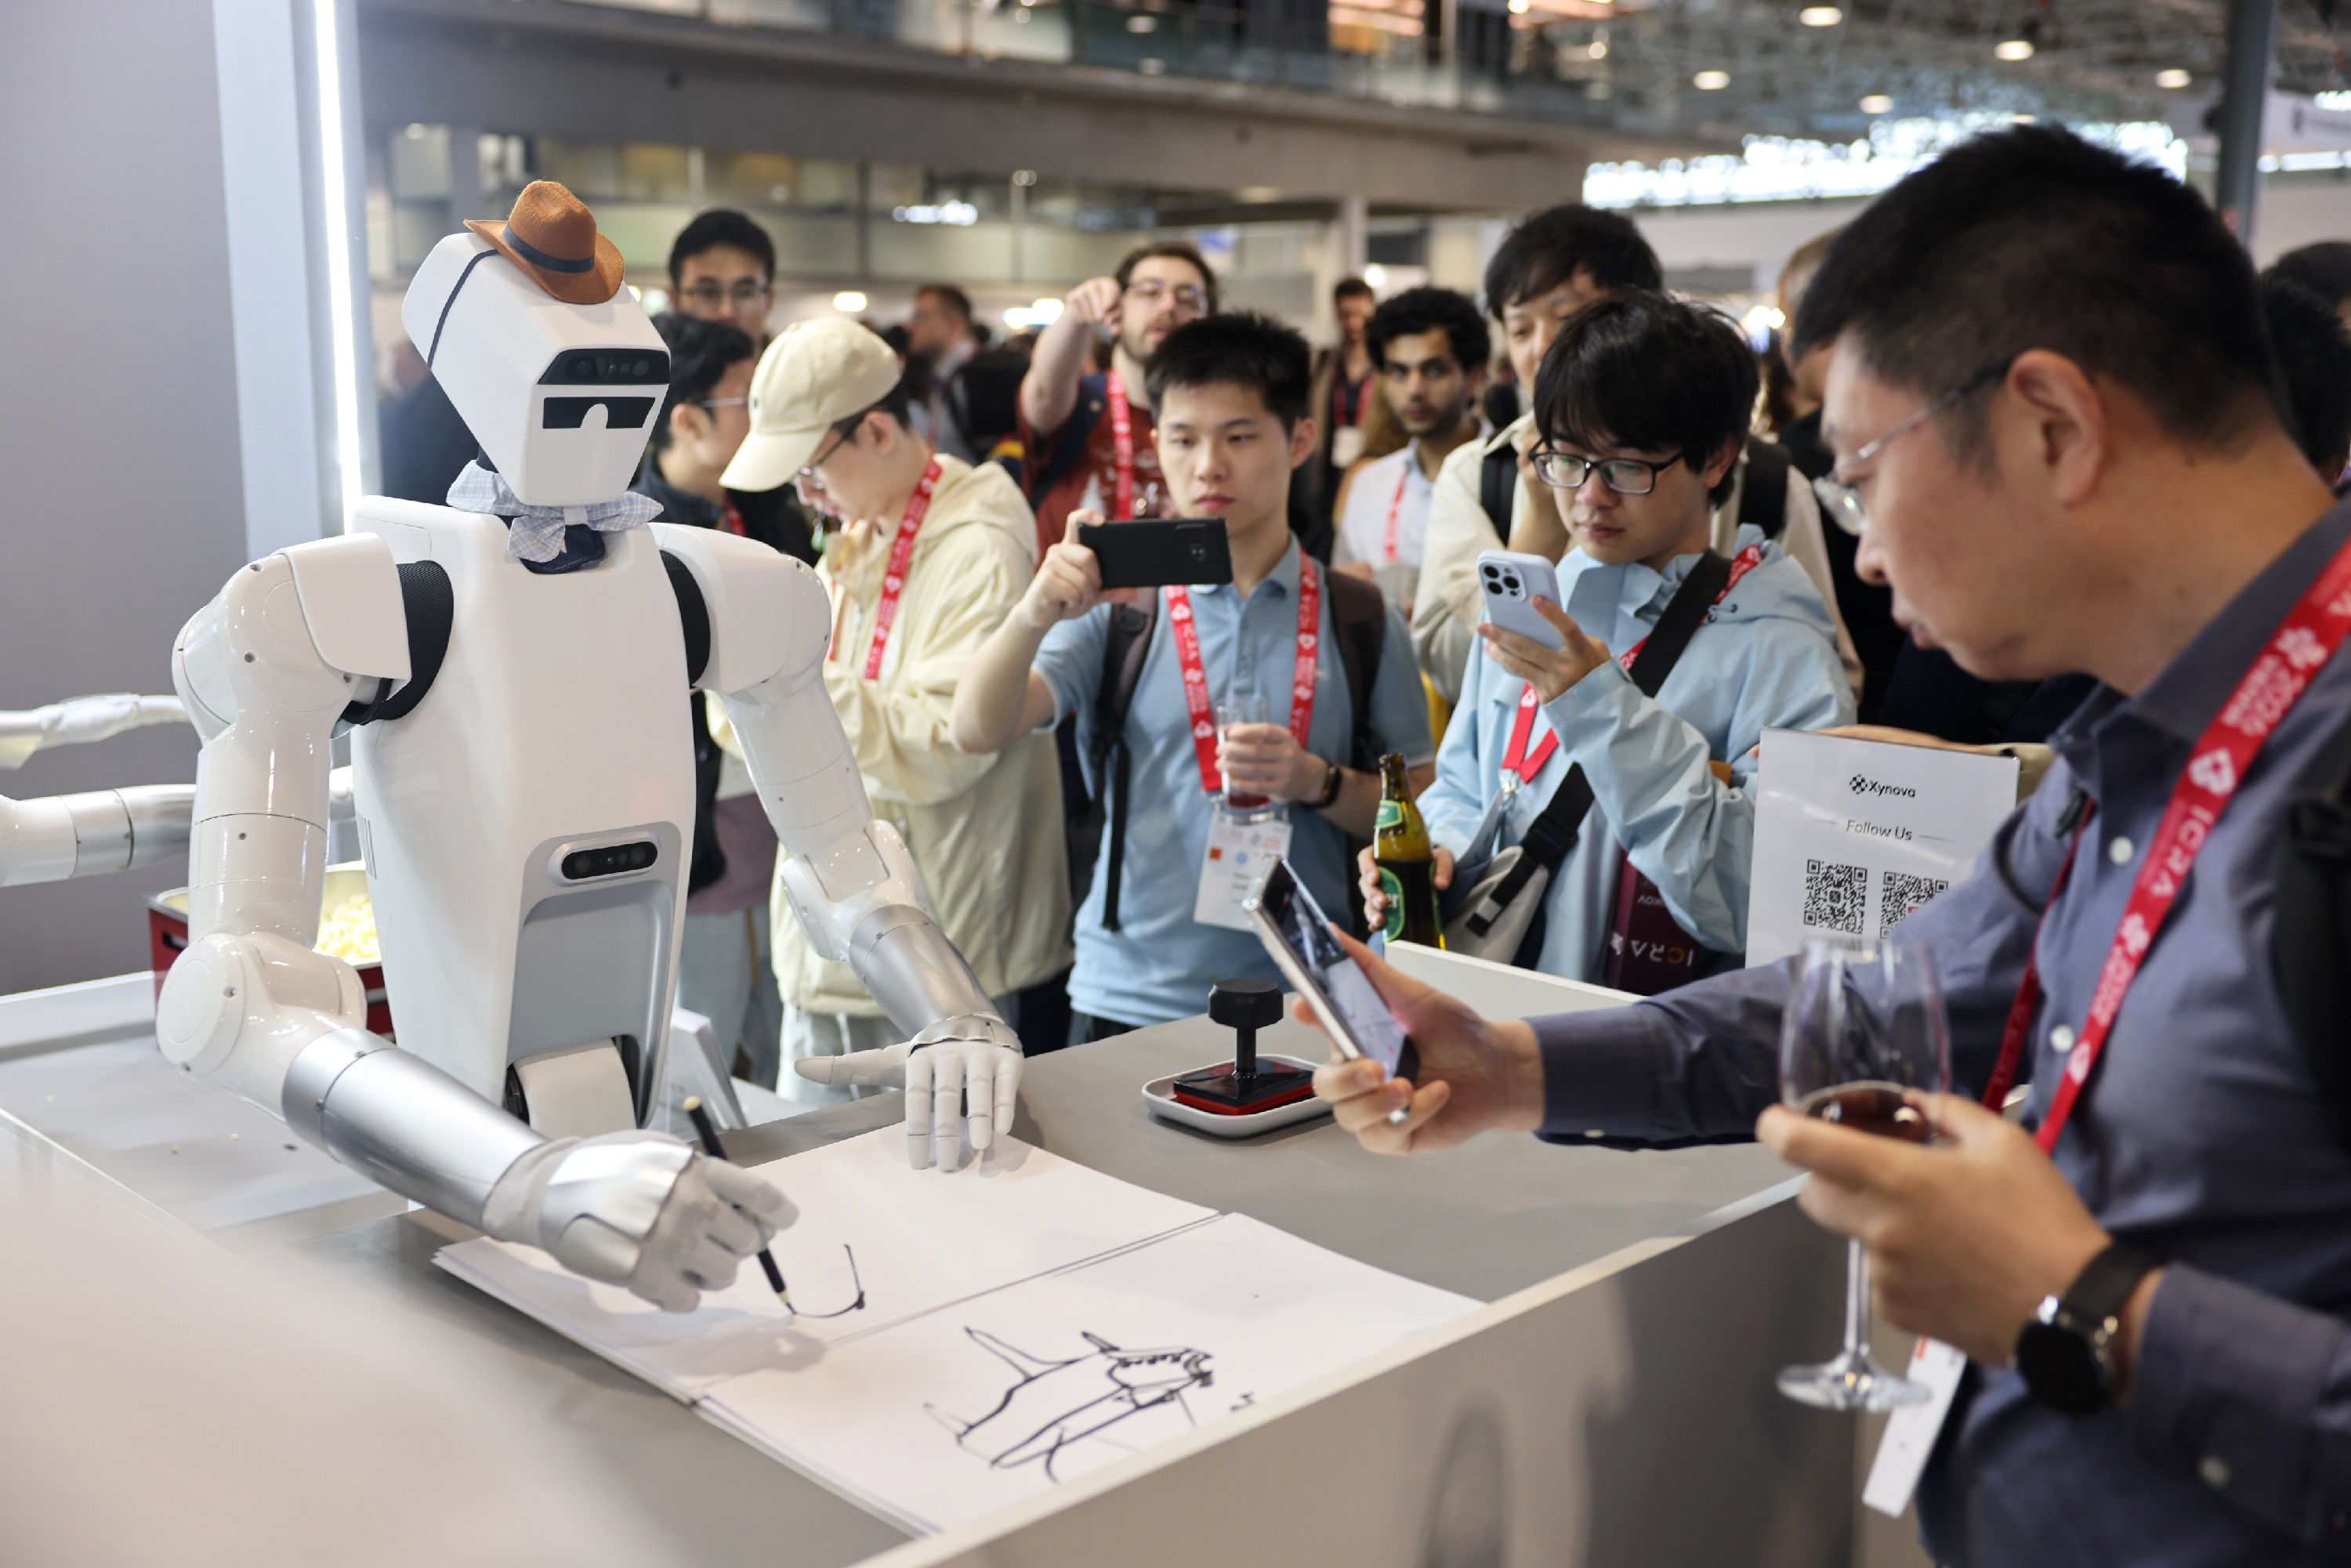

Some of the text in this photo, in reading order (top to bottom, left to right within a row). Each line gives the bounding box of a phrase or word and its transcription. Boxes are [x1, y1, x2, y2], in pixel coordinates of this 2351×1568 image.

[1868, 780, 1916, 798] Xynova
[1846, 820, 1913, 841] Follow Us
[2150, 804, 2215, 896] ICRA
[1631, 940, 1694, 967] ICRA
